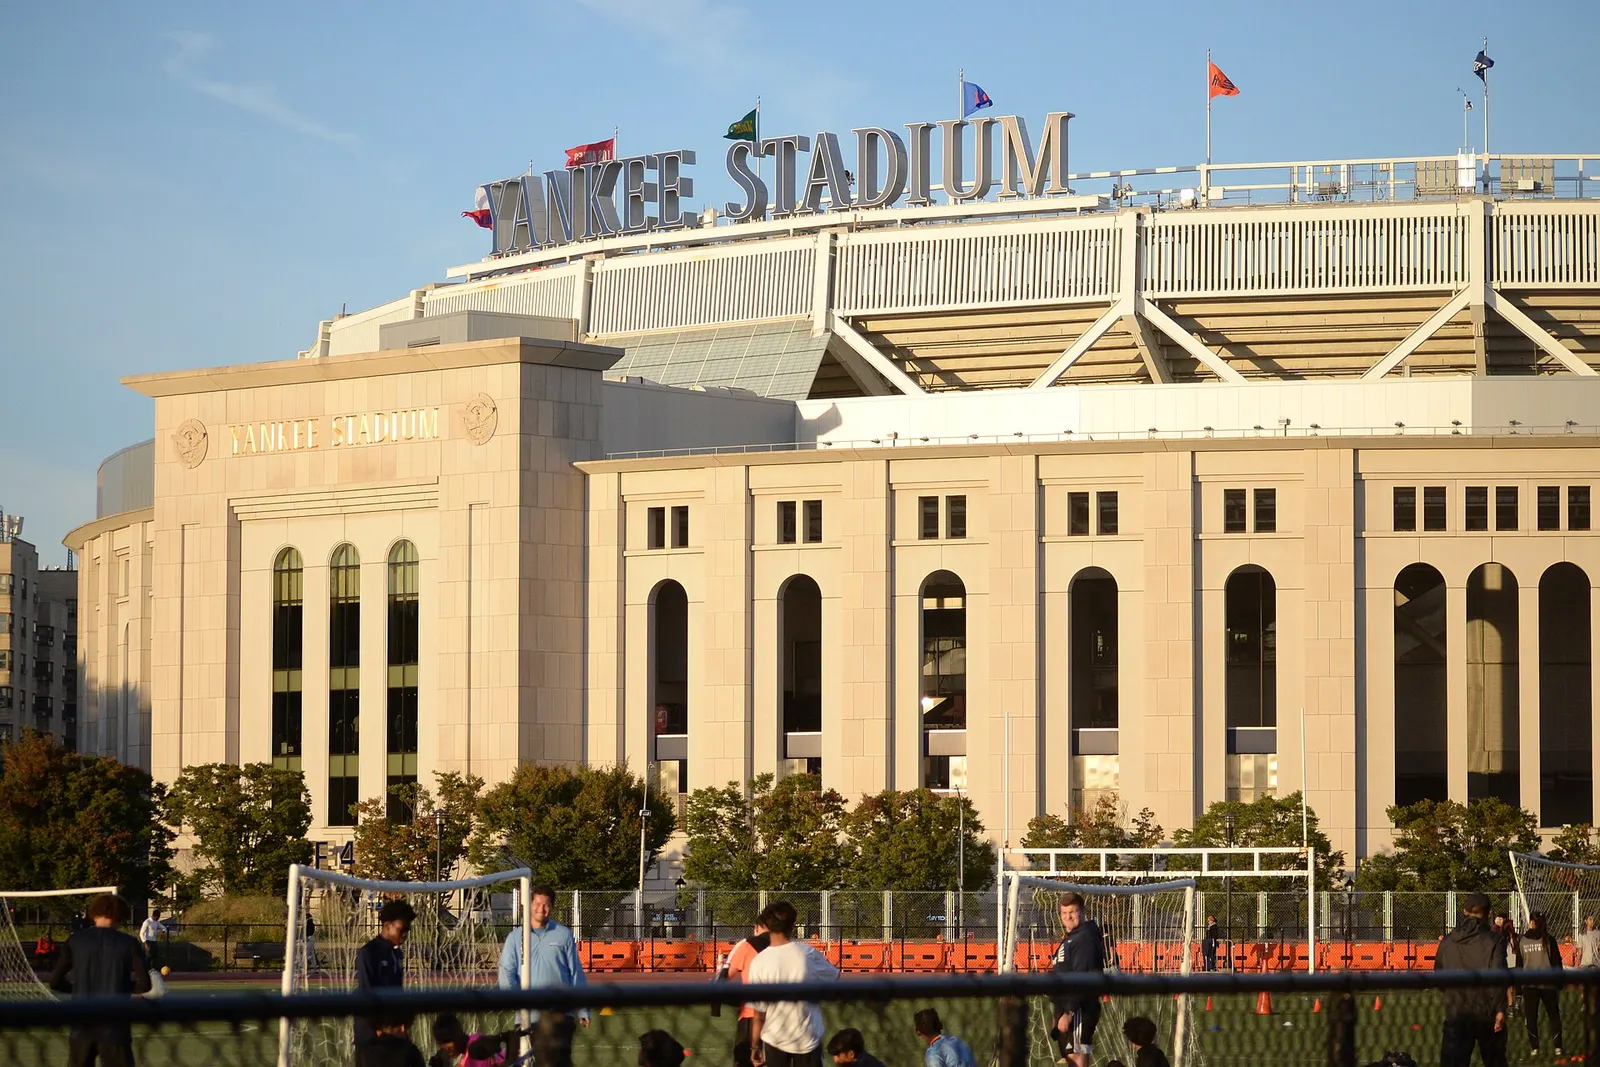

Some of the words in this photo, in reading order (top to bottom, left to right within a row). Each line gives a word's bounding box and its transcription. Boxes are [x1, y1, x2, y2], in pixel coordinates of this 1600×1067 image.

[480, 149, 697, 256] YANKEE
[724, 111, 1075, 220] STADIUM
[228, 418, 319, 455] YANKEE
[331, 407, 440, 447] STADIUM
